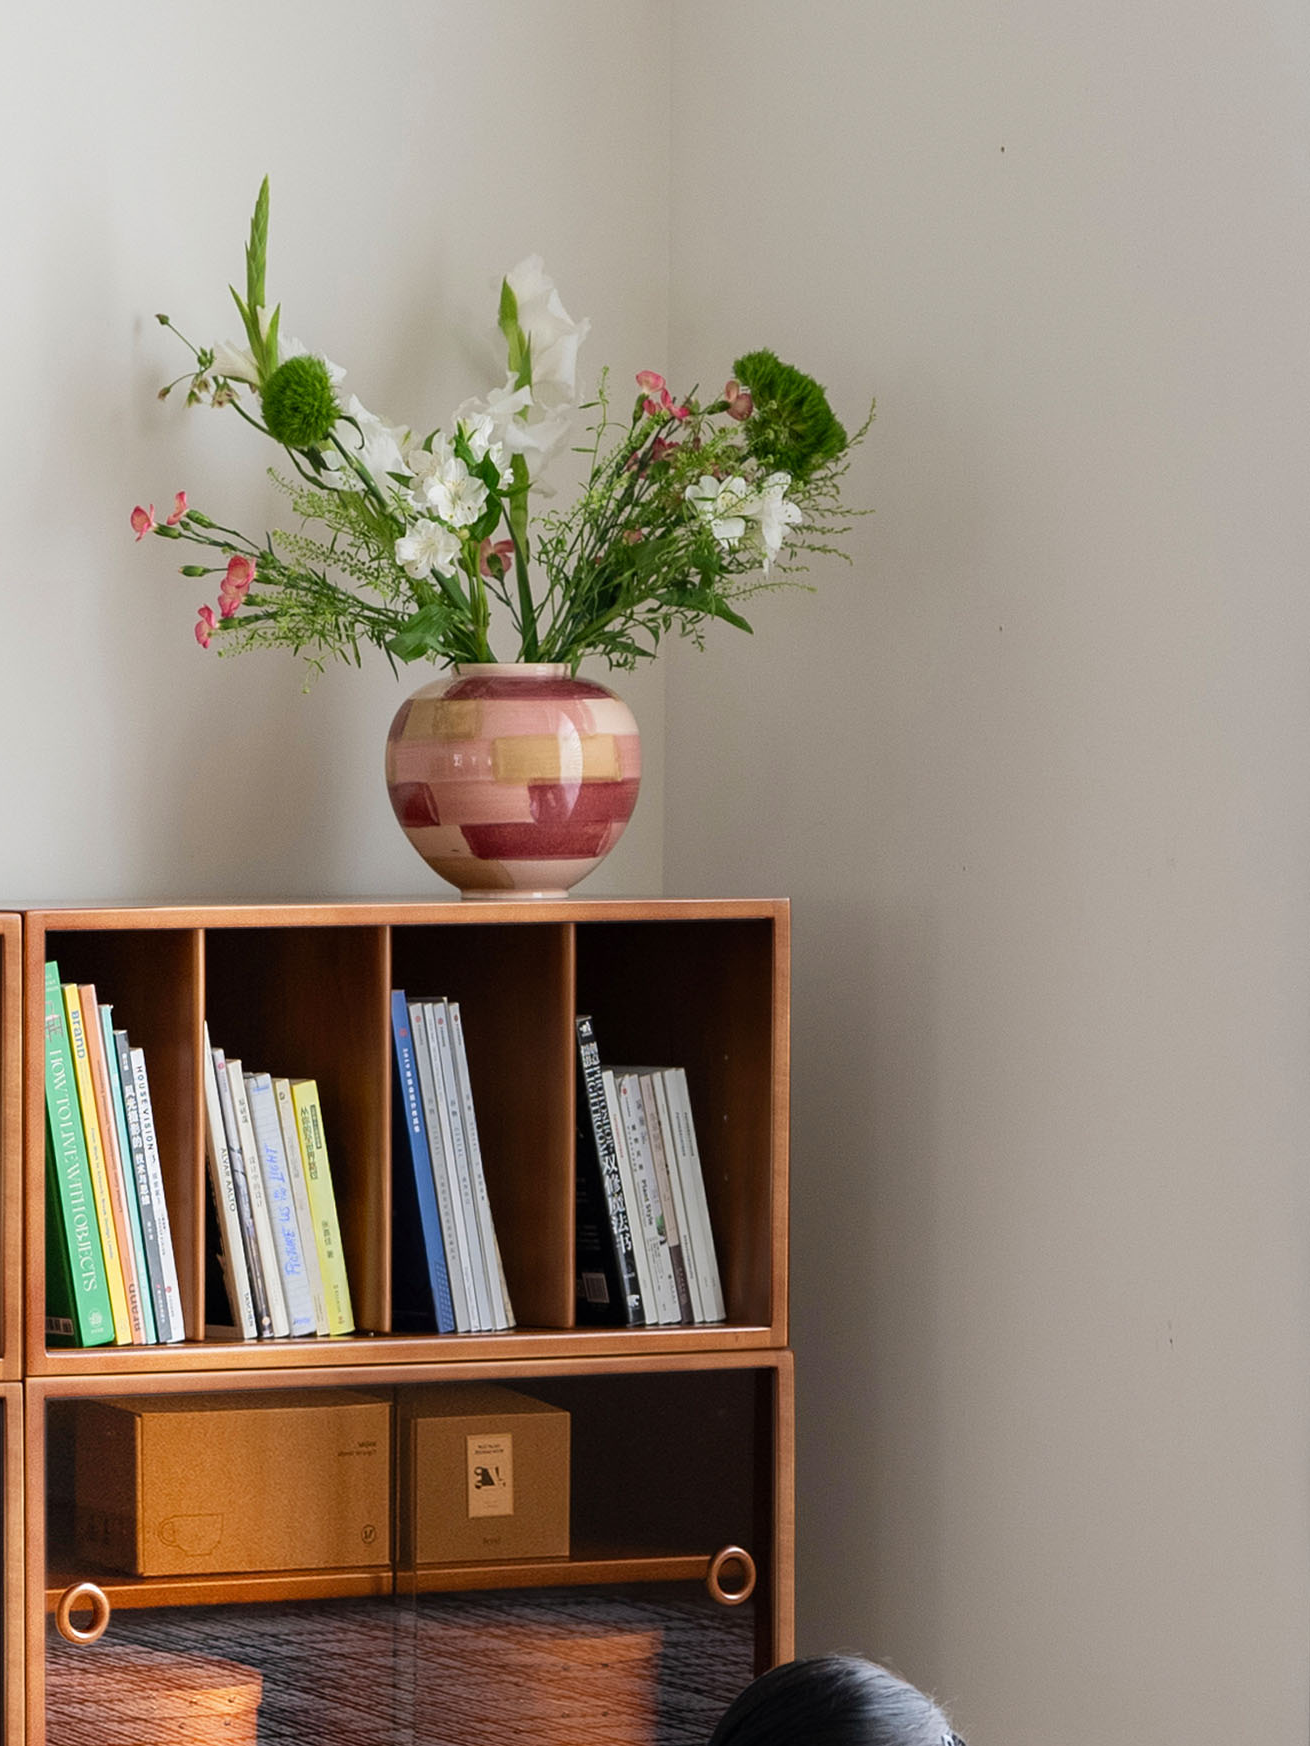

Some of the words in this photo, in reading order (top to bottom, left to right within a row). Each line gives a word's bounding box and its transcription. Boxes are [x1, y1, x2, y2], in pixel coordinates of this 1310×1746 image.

[49, 1049, 69, 1091] HOW
[55, 1092, 73, 1120] TO
[137, 1066, 147, 1104] HOUSE
[143, 1106, 154, 1151] VISION
[60, 1121, 79, 1163] LIVE
[65, 1163, 86, 1212] WITH
[221, 1147, 231, 1177] ALVAR
[226, 1180, 236, 1213] AALTO
[641, 1178, 649, 1201] Plant
[645, 1202, 654, 1226] Style
[73, 1213, 98, 1292] OBJECTS
